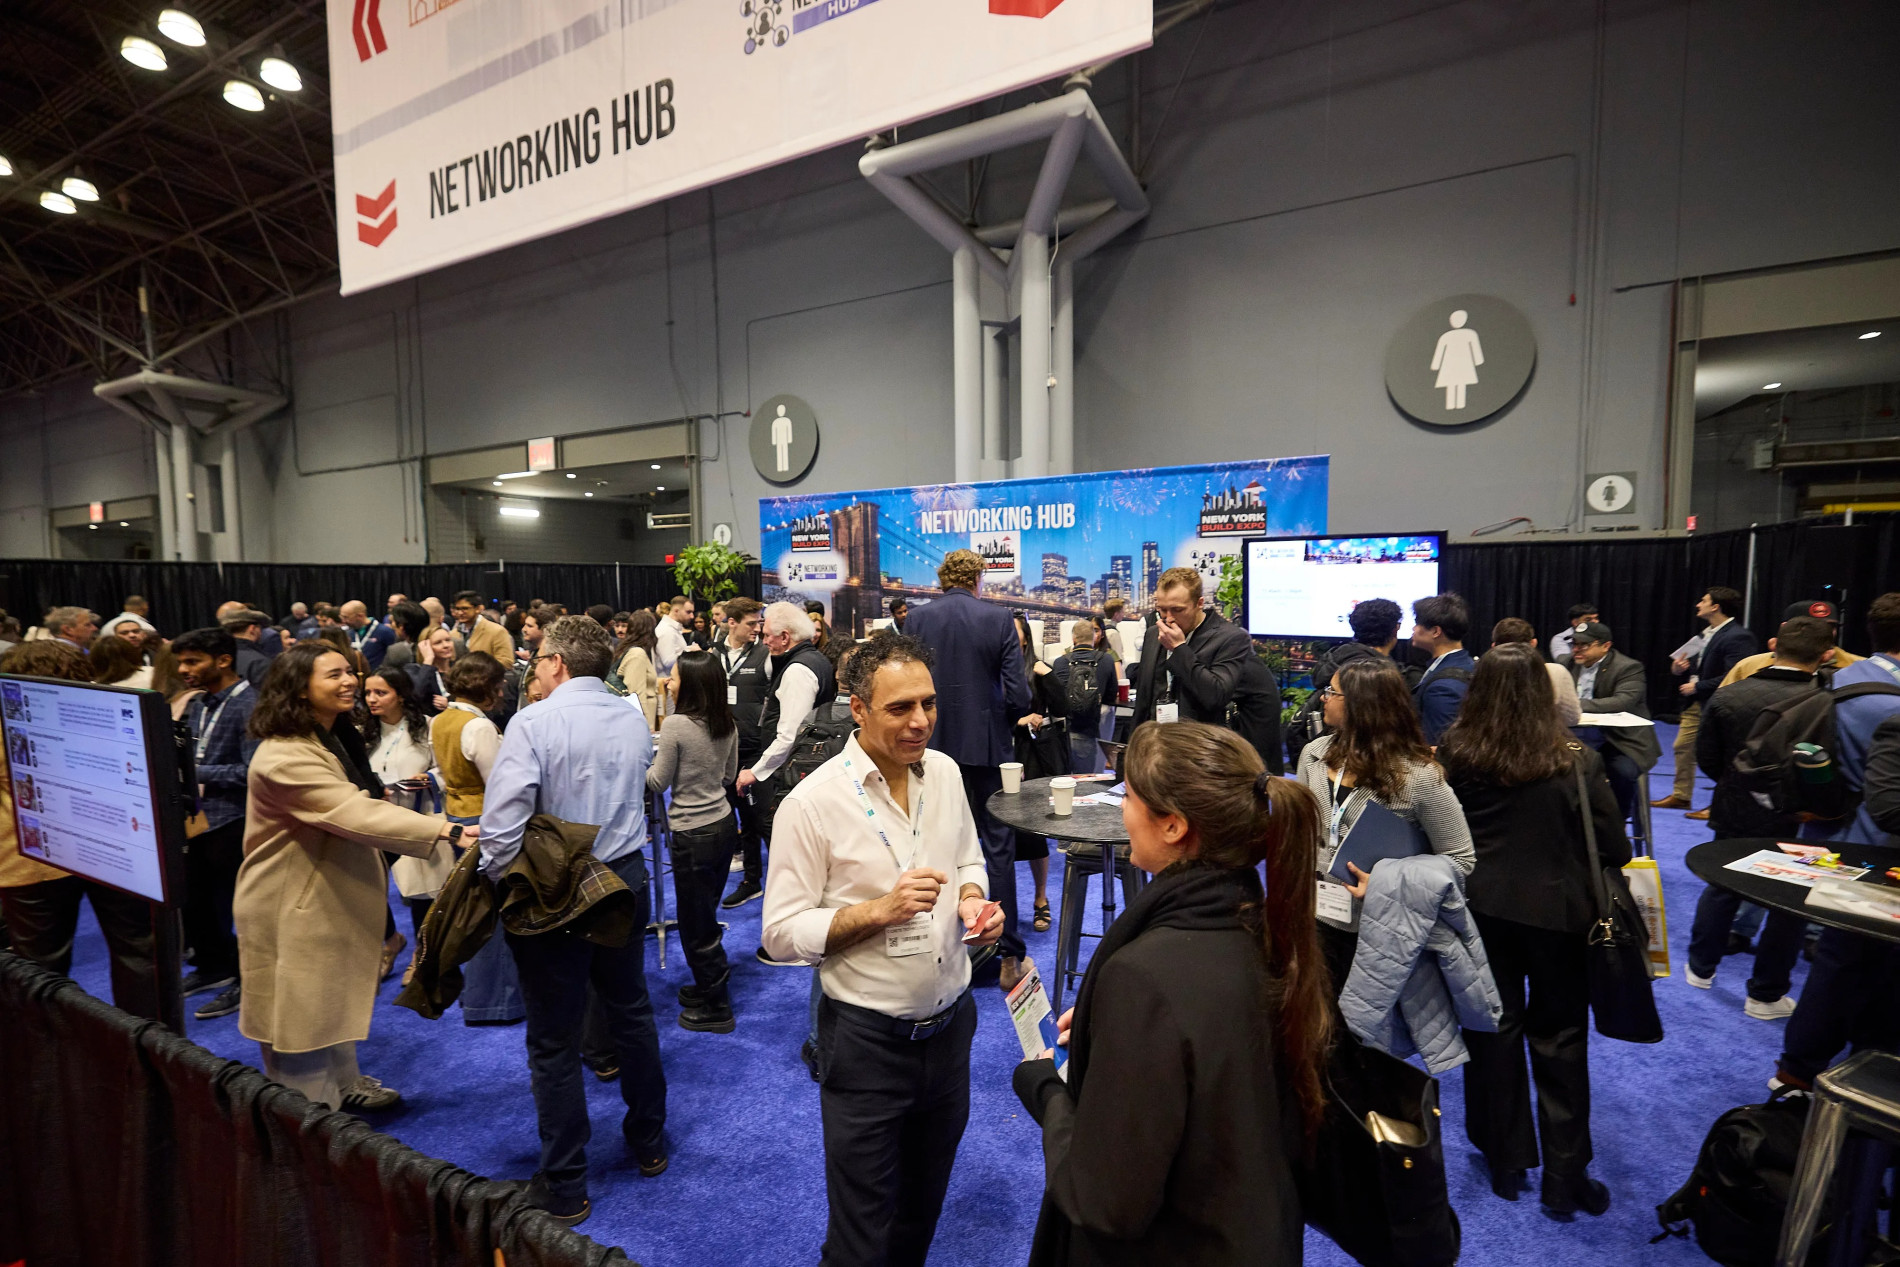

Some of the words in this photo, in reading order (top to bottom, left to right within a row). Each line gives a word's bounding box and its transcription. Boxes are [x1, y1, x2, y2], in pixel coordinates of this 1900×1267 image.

[429, 107, 601, 219] NETWORKING
[611, 77, 676, 155] HUB
[921, 505, 1032, 534] NETWORKING
[1037, 503, 1076, 529] HUB
[1201, 515, 1230, 524] NEW
[1232, 512, 1266, 522] YORK
[1201, 523, 1234, 531] BUILD
[1236, 521, 1266, 530] EXPO
[809, 533, 830, 541] YORK
[804, 564, 837, 573] NETWORKING
